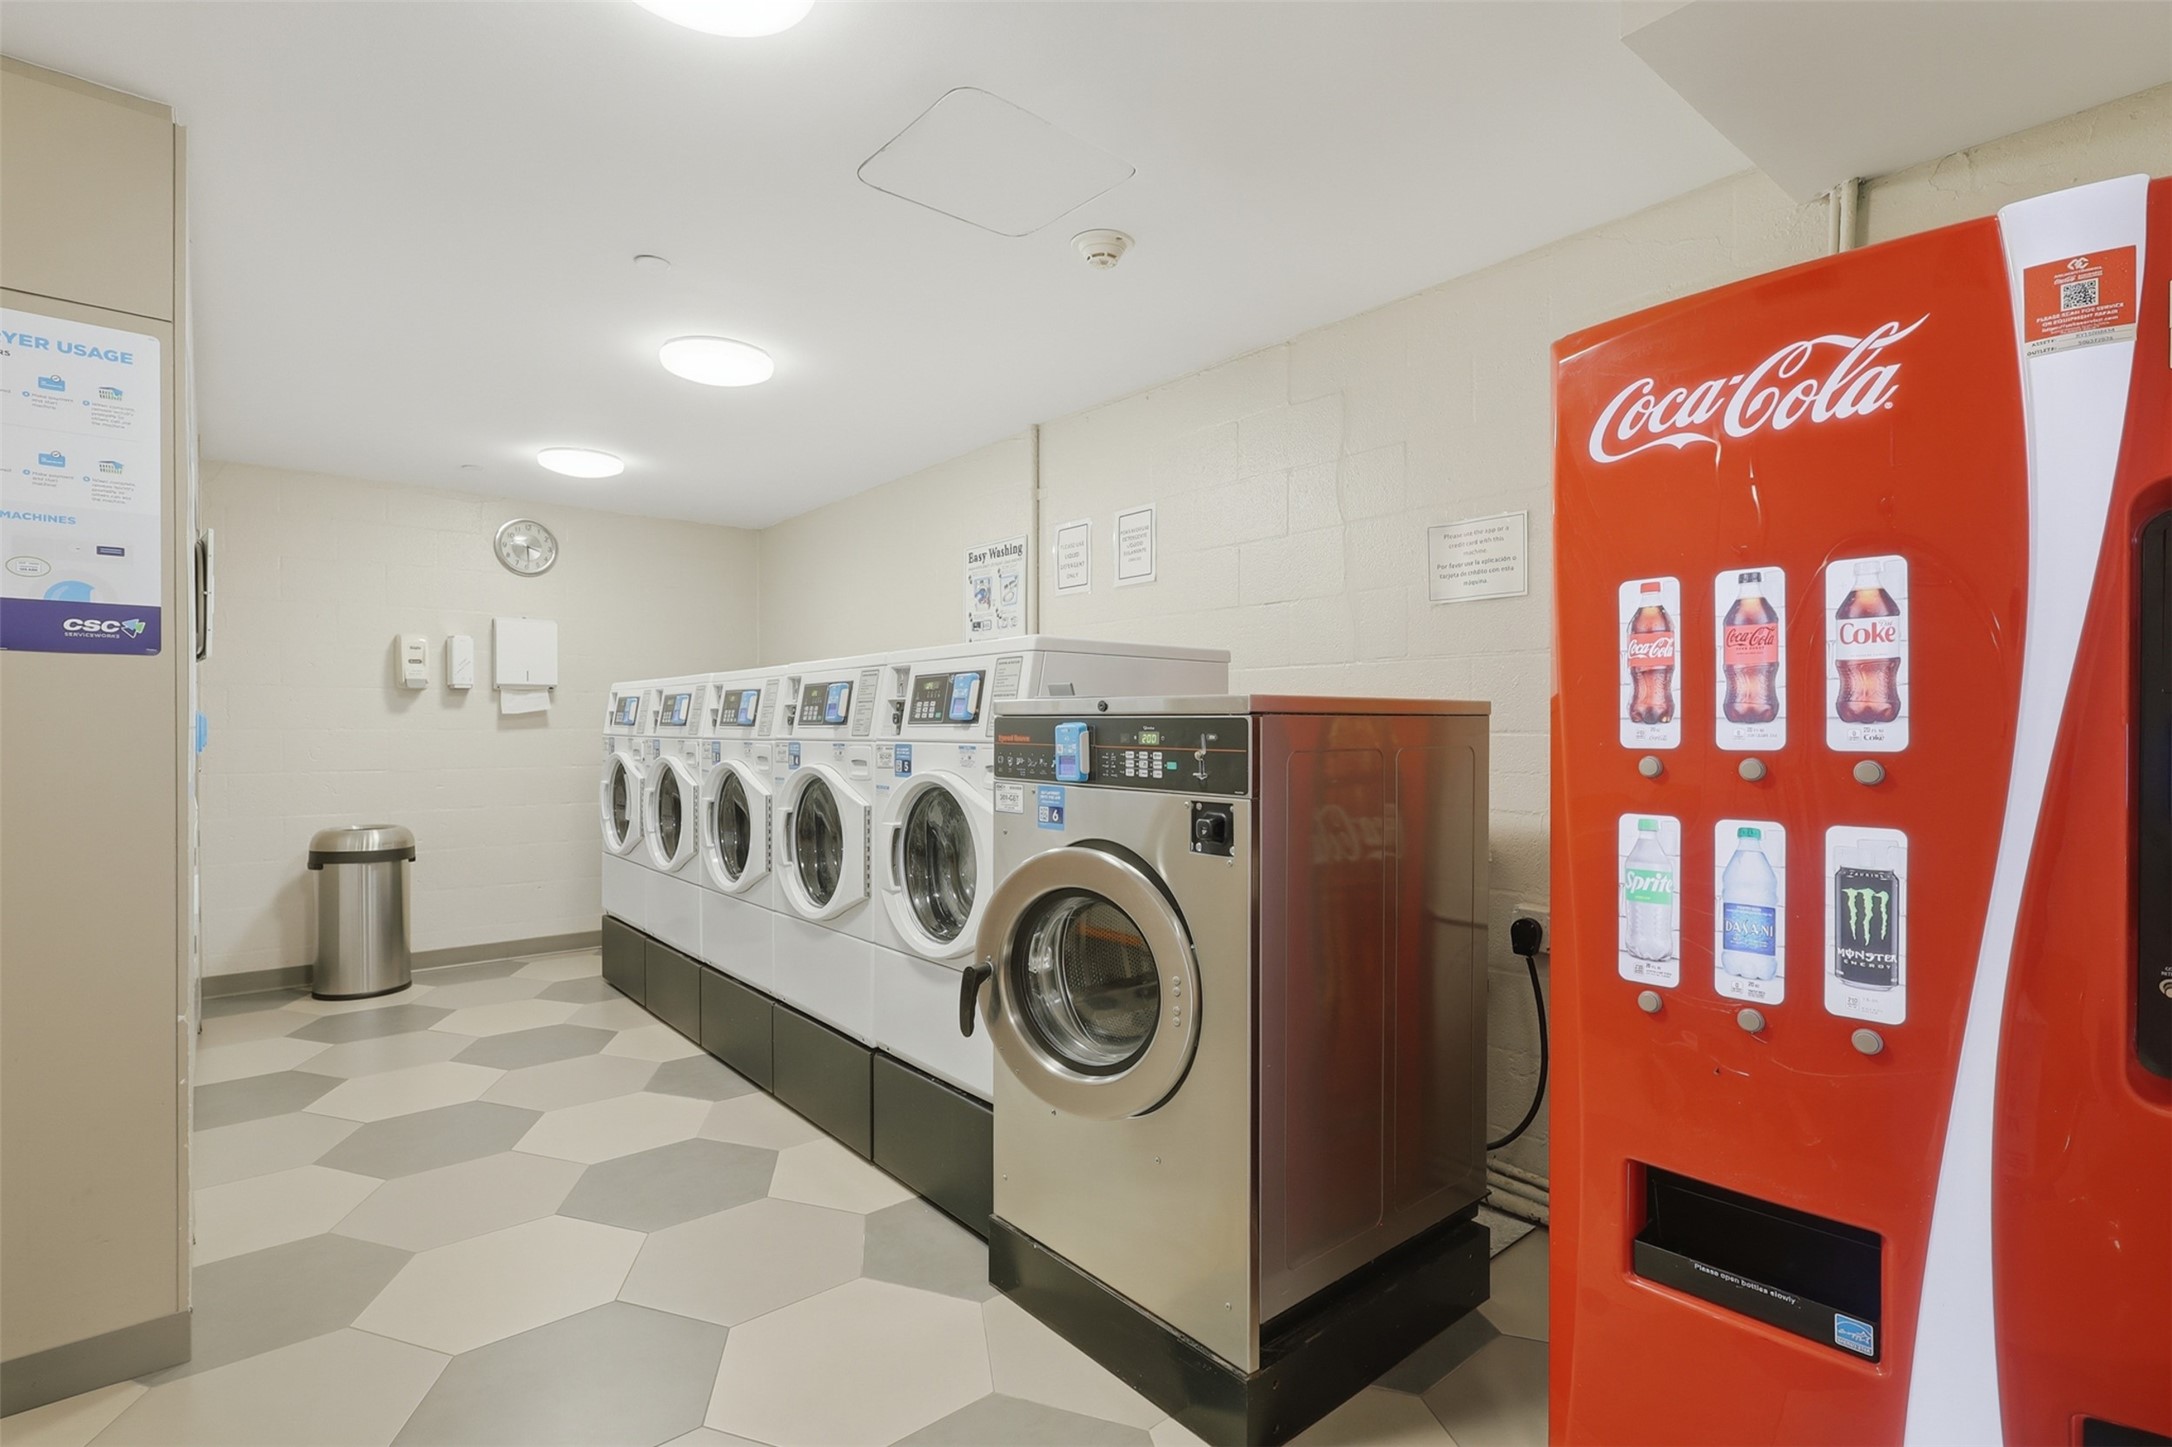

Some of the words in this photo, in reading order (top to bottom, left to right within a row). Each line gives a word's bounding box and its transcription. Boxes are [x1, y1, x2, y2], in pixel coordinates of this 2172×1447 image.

[2036, 314, 2060, 323] PLEASE
[2097, 302, 2124, 311] SERVICE
[2053, 314, 2093, 324] EQUIPMENT
[0, 329, 50, 350] YER
[57, 340, 134, 365] USAGE
[1589, 312, 1930, 463] Coca-Cola
[0, 510, 76, 525] MACHINES
[968, 552, 987, 564] Easy
[989, 544, 1023, 560] Washing
[1060, 561, 1085, 570] DETERGENT
[63, 618, 122, 633] CSC
[1840, 622, 1896, 645] Coke
[1726, 626, 1775, 647] Coca-Cola
[1628, 637, 1674, 659] Coca-Cola
[1142, 734, 1157, 743] 200
[904, 762, 909, 771] 5
[1052, 809, 1058, 821] 6
[1626, 870, 1673, 894] Sprite
[1726, 920, 1773, 937] DASANI
[1837, 947, 1897, 963] MONSTER
[1844, 960, 1891, 970] ENERGY
[1694, 1263, 1719, 1277] Please
[1720, 1272, 1740, 1284] open
[1741, 1280, 1768, 1294] bottles
[1770, 1290, 1797, 1305] slowly
